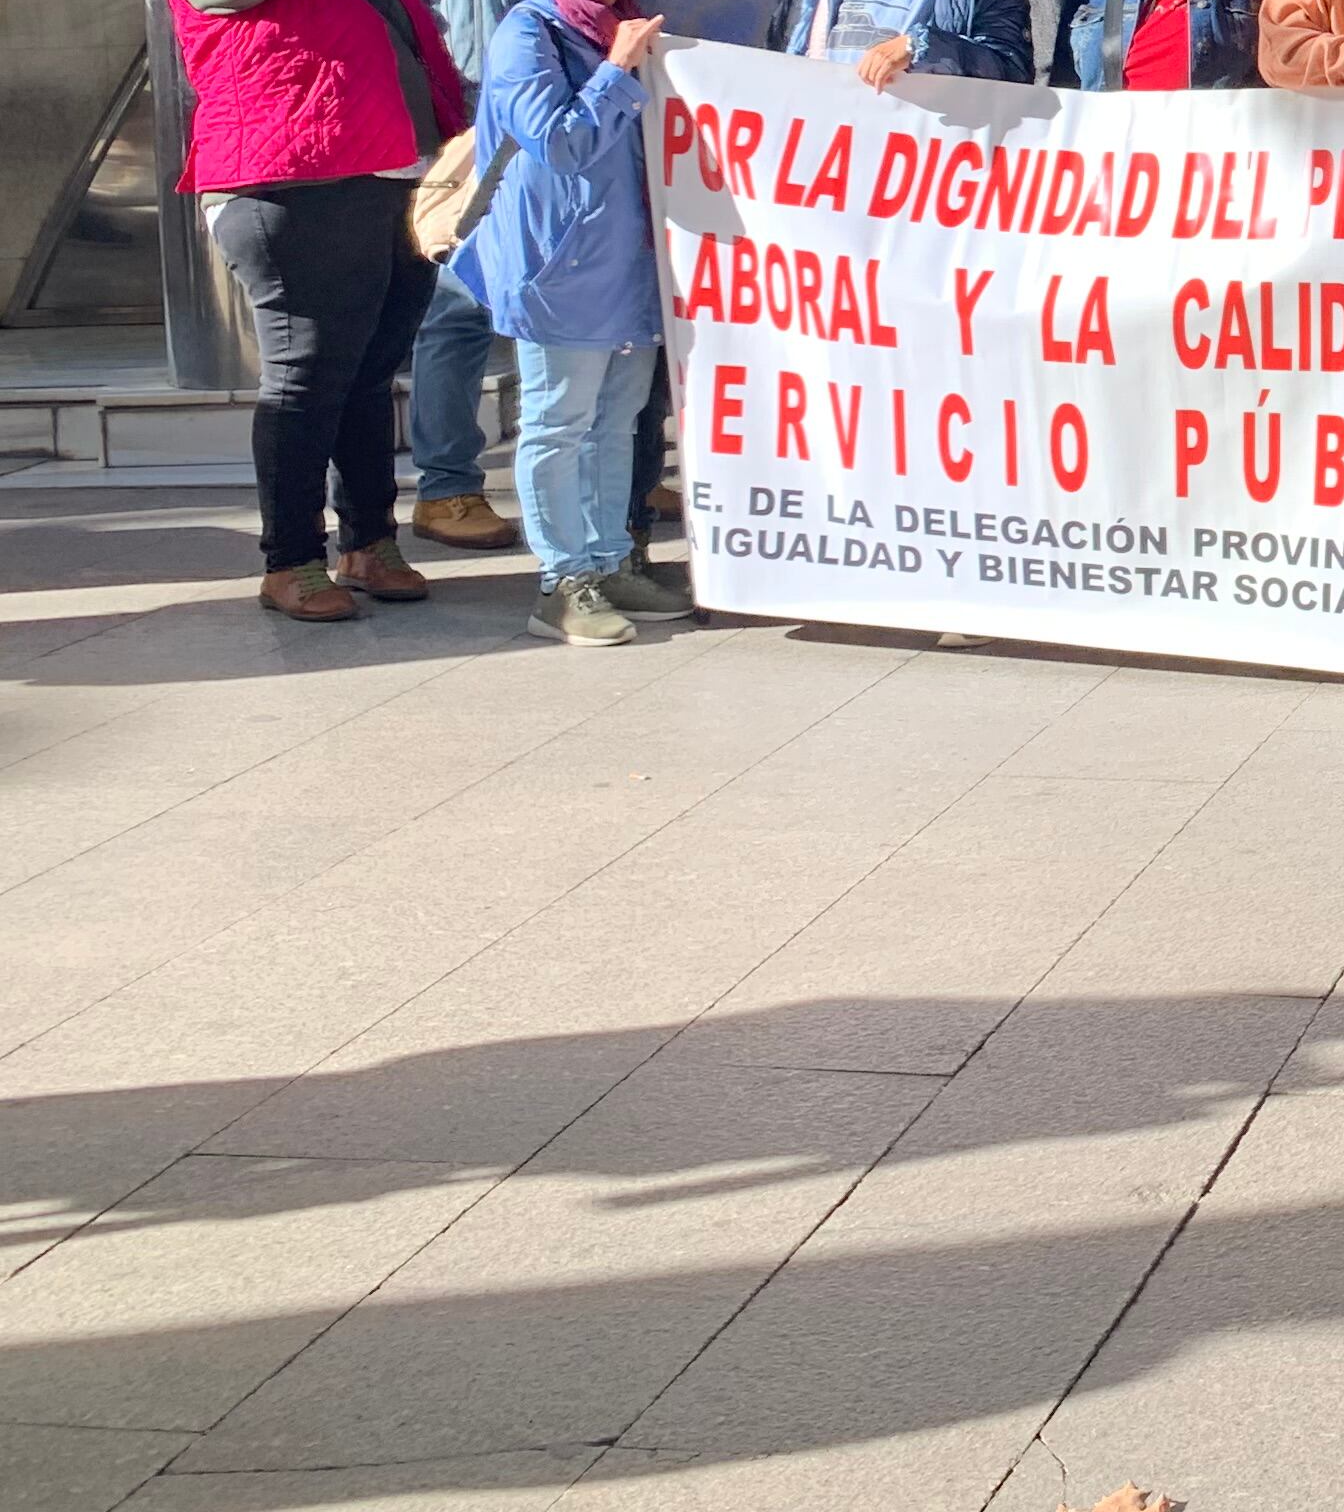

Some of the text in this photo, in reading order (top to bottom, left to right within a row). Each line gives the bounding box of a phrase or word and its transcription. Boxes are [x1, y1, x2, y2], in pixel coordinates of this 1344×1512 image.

[663, 97, 764, 200] POR
[773, 118, 853, 212] LA
[867, 132, 1160, 238] DIGNIDAD
[1172, 152, 1275, 239] DEL
[955, 268, 993, 356] Y
[1041, 275, 1116, 365] LA
[679, 365, 1088, 493] ERVICIO
[713, 529, 921, 572] IGUALDAD
[937, 549, 962, 577] Y
[979, 554, 1217, 601] BIENESTAR
[749, 487, 803, 519] DE
[828, 495, 873, 528] LA
[895, 505, 1167, 555] DELEGACIÓN
